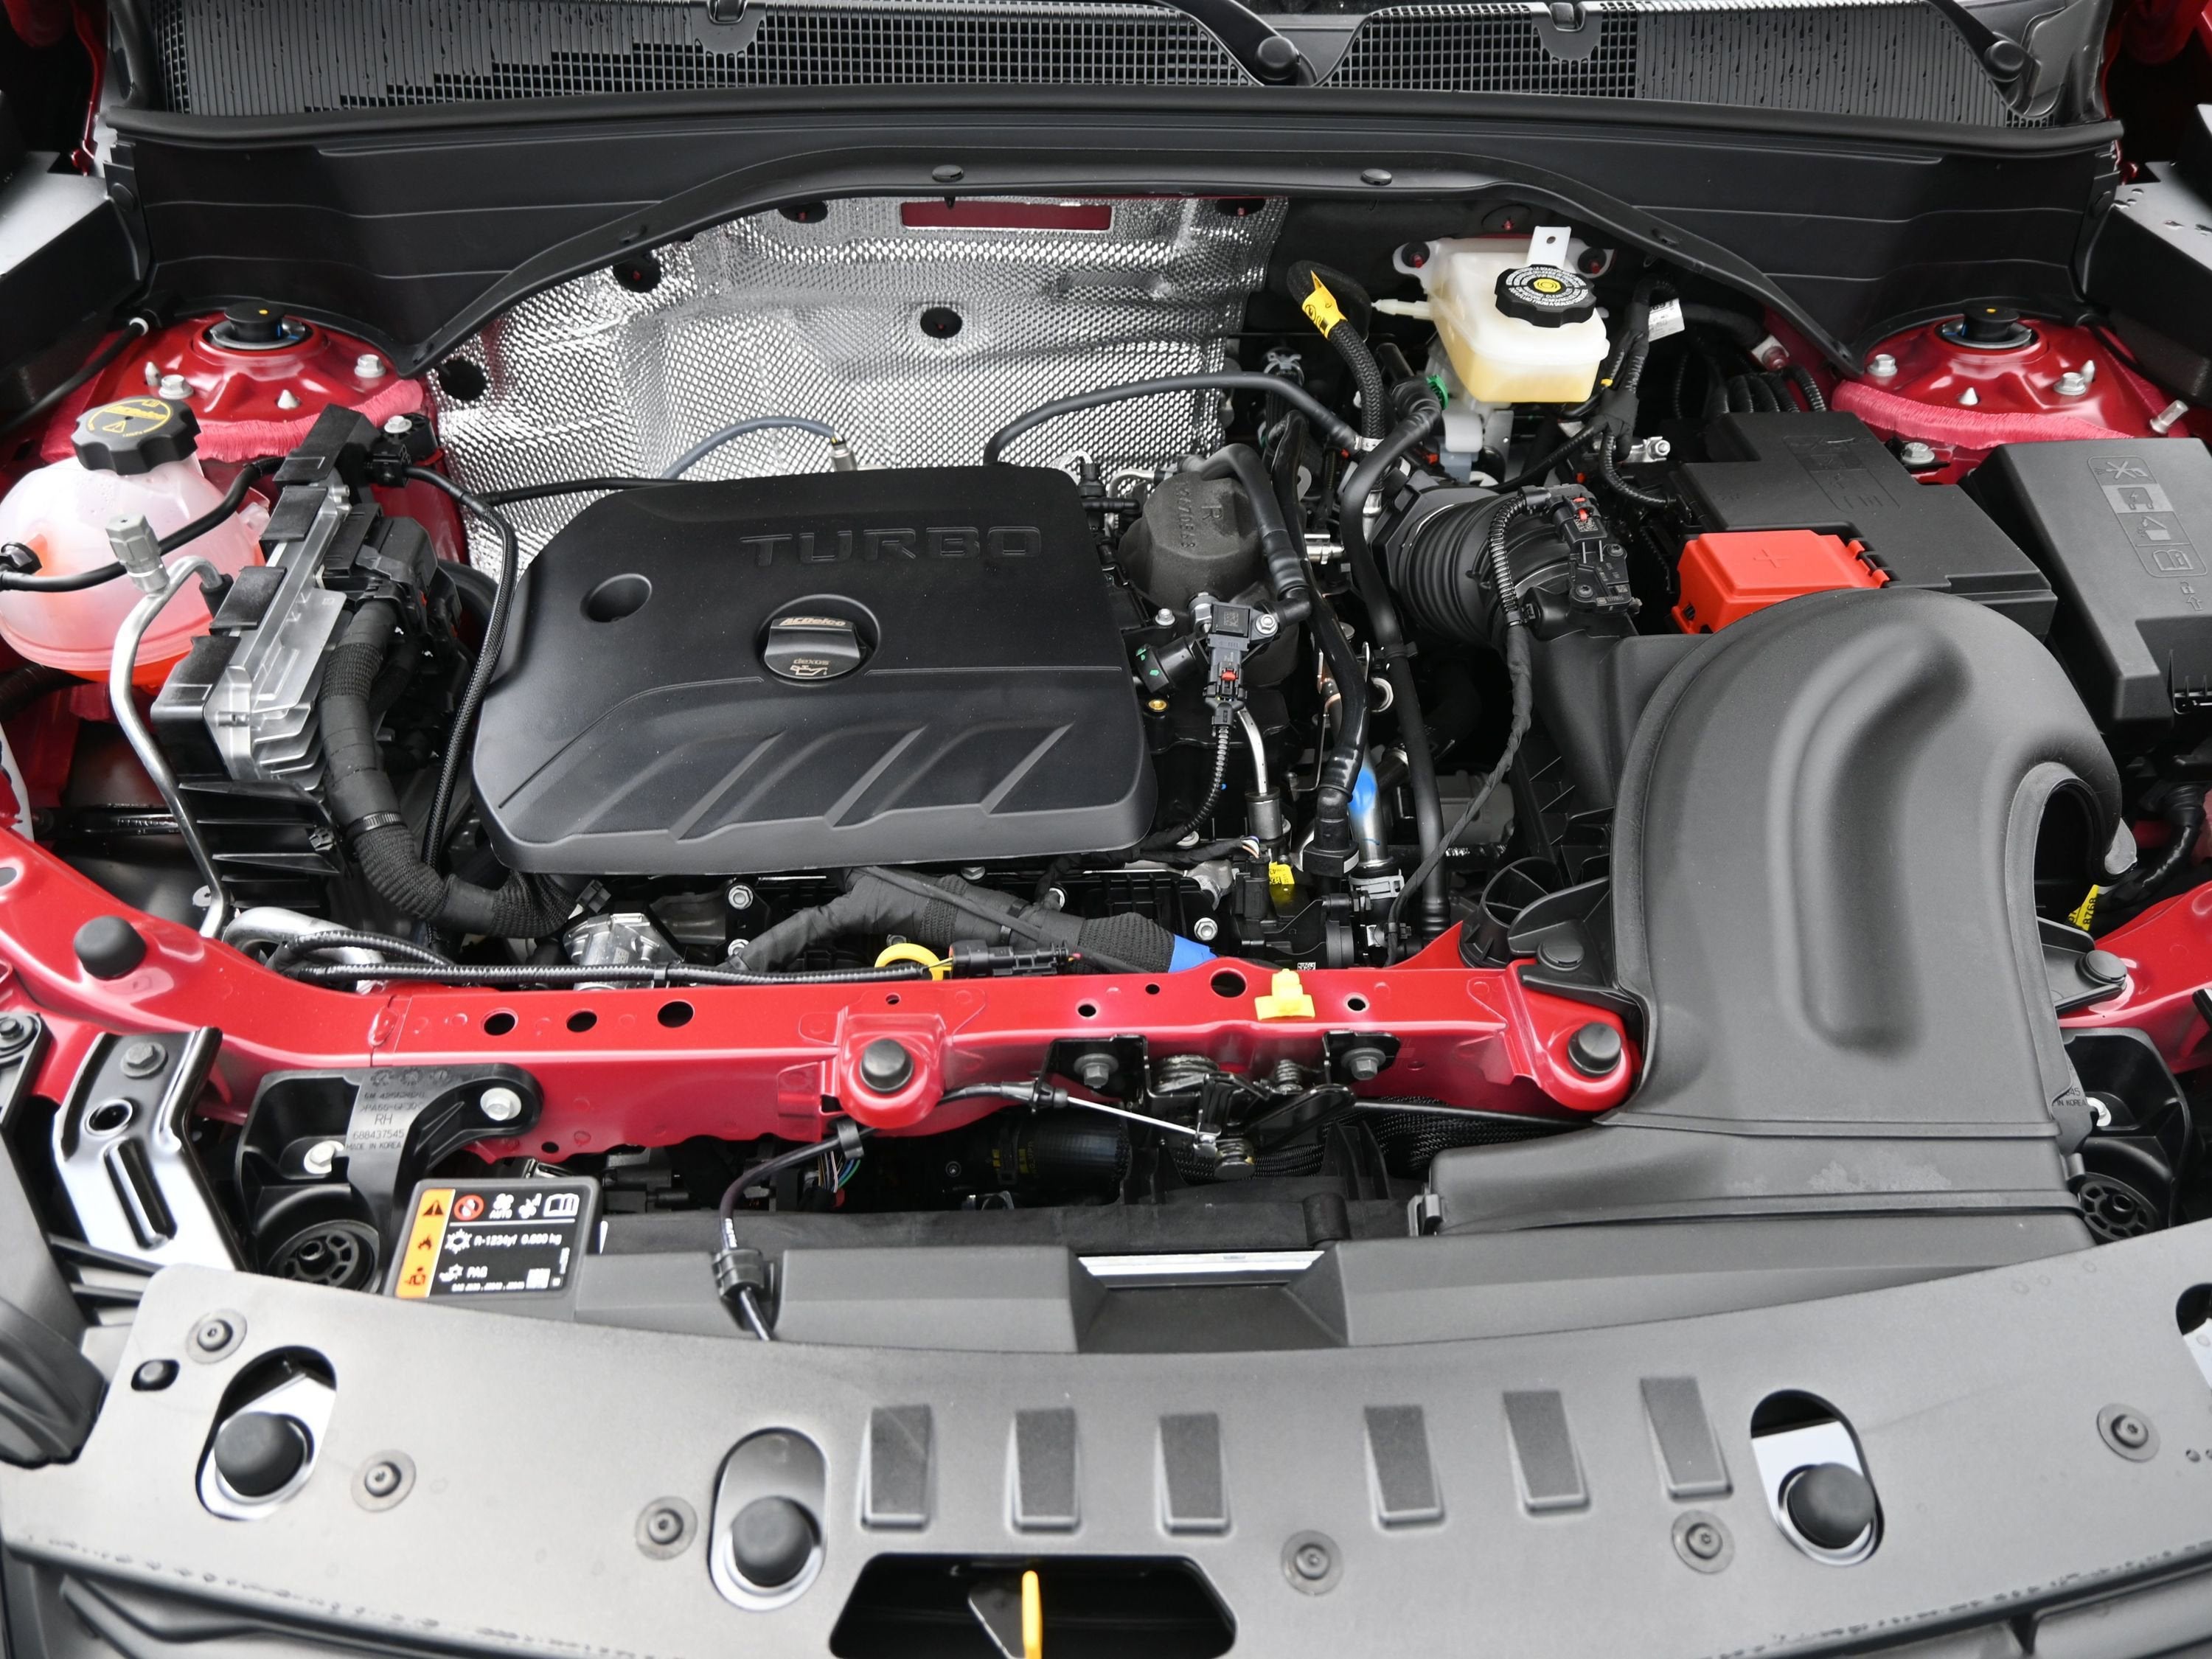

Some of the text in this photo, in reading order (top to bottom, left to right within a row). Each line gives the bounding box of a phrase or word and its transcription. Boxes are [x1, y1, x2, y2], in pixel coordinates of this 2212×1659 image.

[1201, 504, 1222, 521] R
[740, 526, 1041, 566] TURBO
[779, 617, 846, 627] ACDelco
[2065, 1099, 2087, 1107] KOREA
[375, 1113, 392, 1124] RH
[353, 1128, 405, 1139] 688437545
[346, 1143, 364, 1151] MADE
